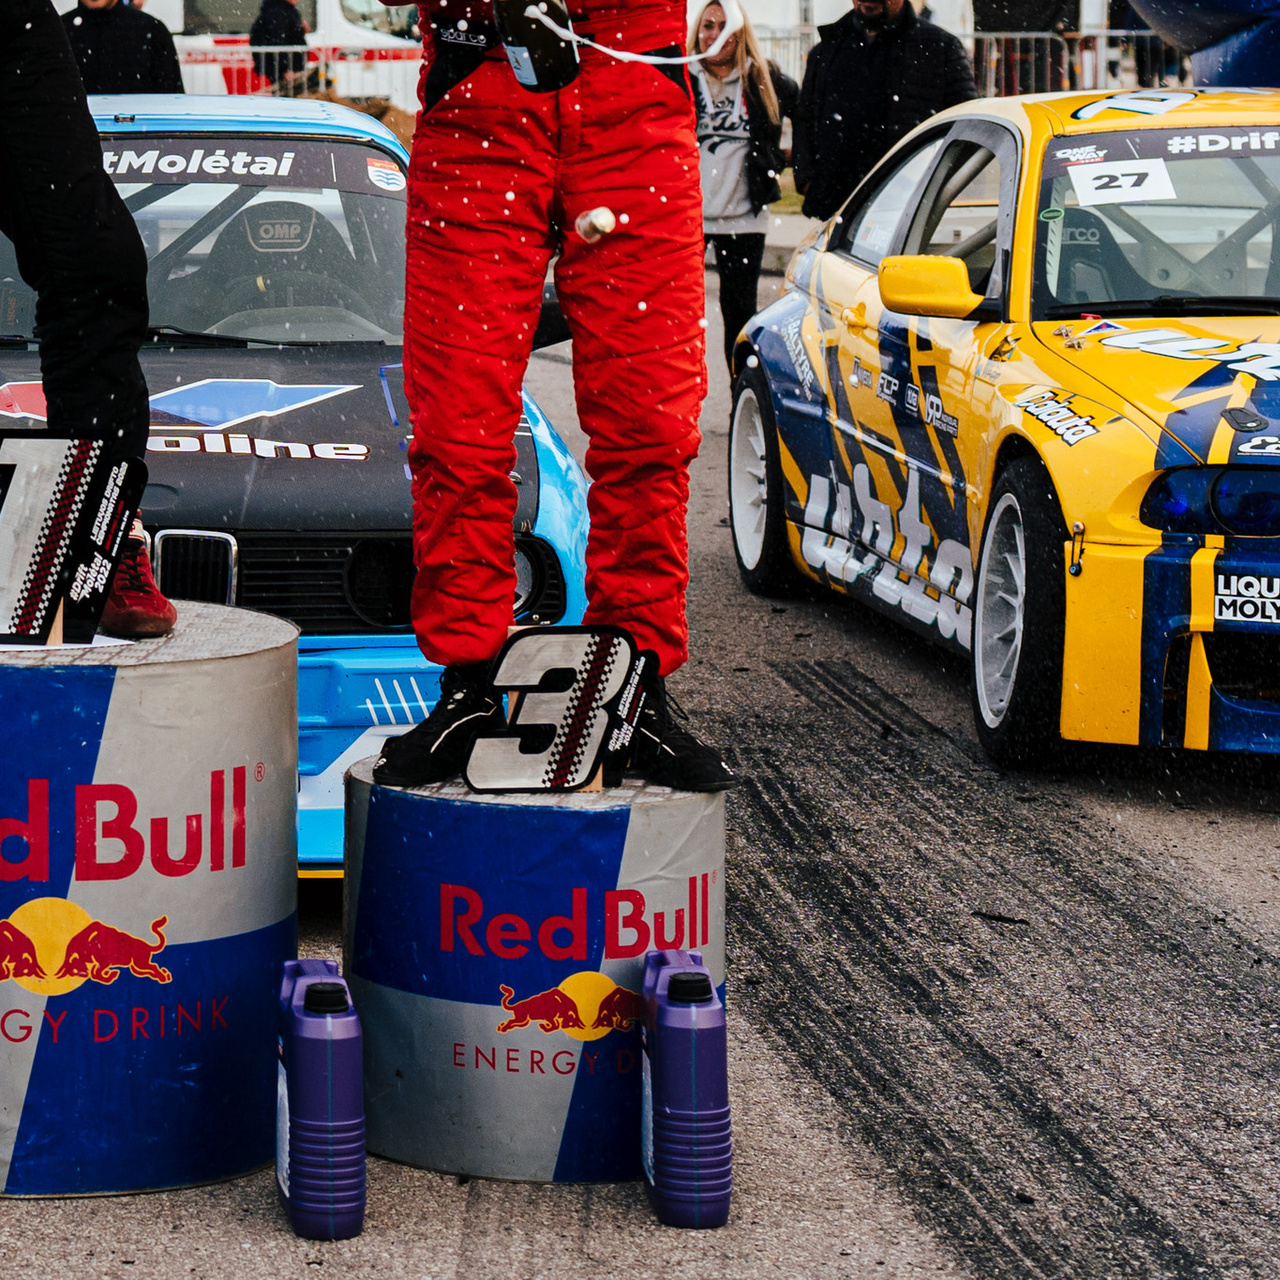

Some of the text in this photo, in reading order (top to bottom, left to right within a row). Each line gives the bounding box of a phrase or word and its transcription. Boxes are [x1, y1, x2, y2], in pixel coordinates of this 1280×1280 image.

[1069, 149, 1108, 162] WAY
[1091, 172, 1149, 190] 27
[259, 223, 301, 240] OMP
[787, 320, 815, 388] BALTYRE
[70, 563, 88, 601] #Drift
[94, 559, 112, 593] 2022
[463, 627, 635, 792] 3
[75, 765, 247, 882] Bull
[439, 872, 709, 961] Red Bull
[93, 995, 230, 1043] DRINK
[453, 1041, 600, 1076] ENERGY
